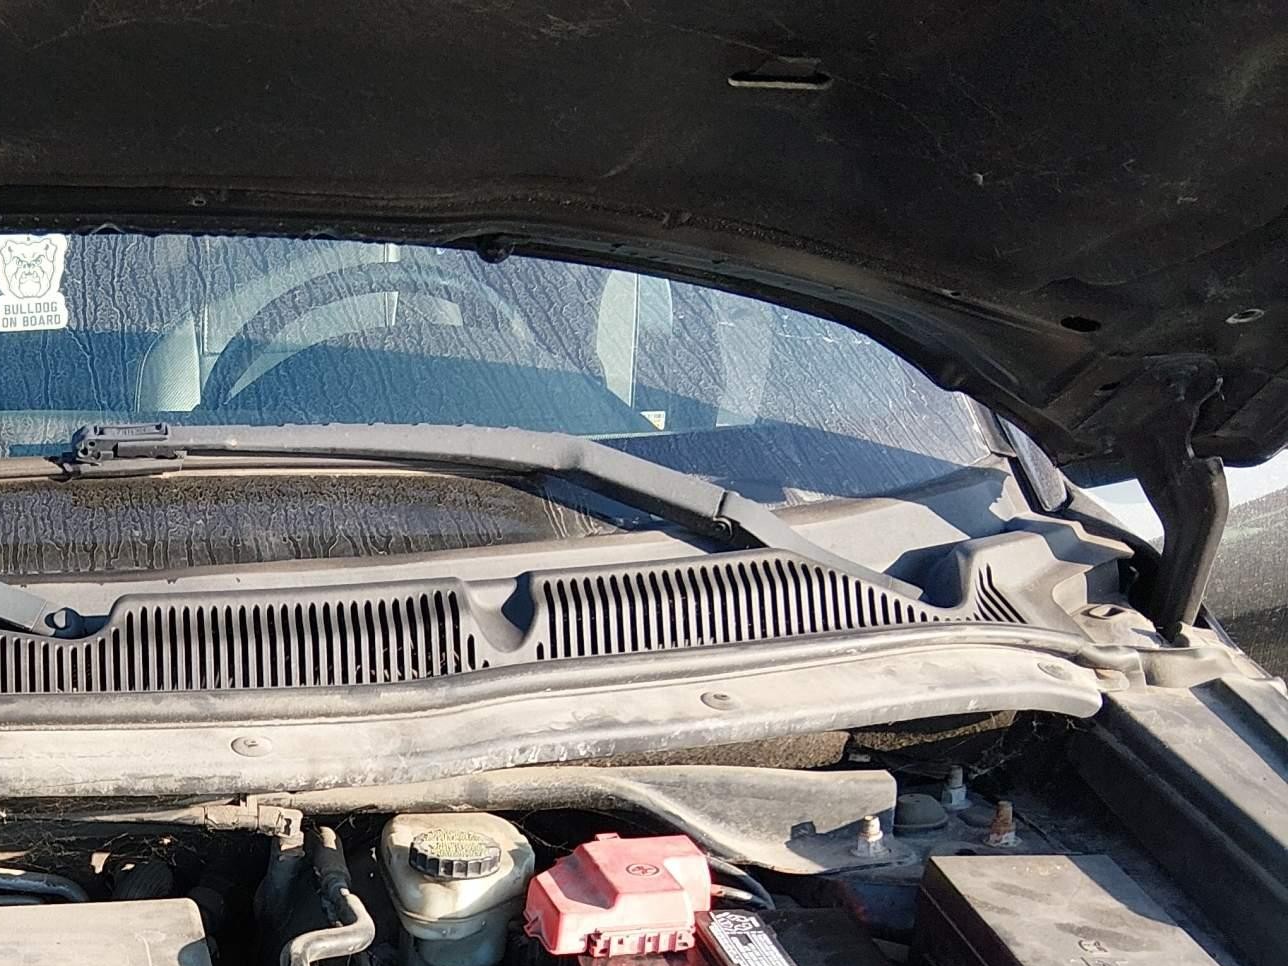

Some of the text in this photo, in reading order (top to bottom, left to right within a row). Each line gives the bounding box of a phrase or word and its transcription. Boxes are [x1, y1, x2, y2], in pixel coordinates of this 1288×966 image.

[4, 302, 58, 315] BULLDOG
[2, 314, 61, 328] ON BOARD
